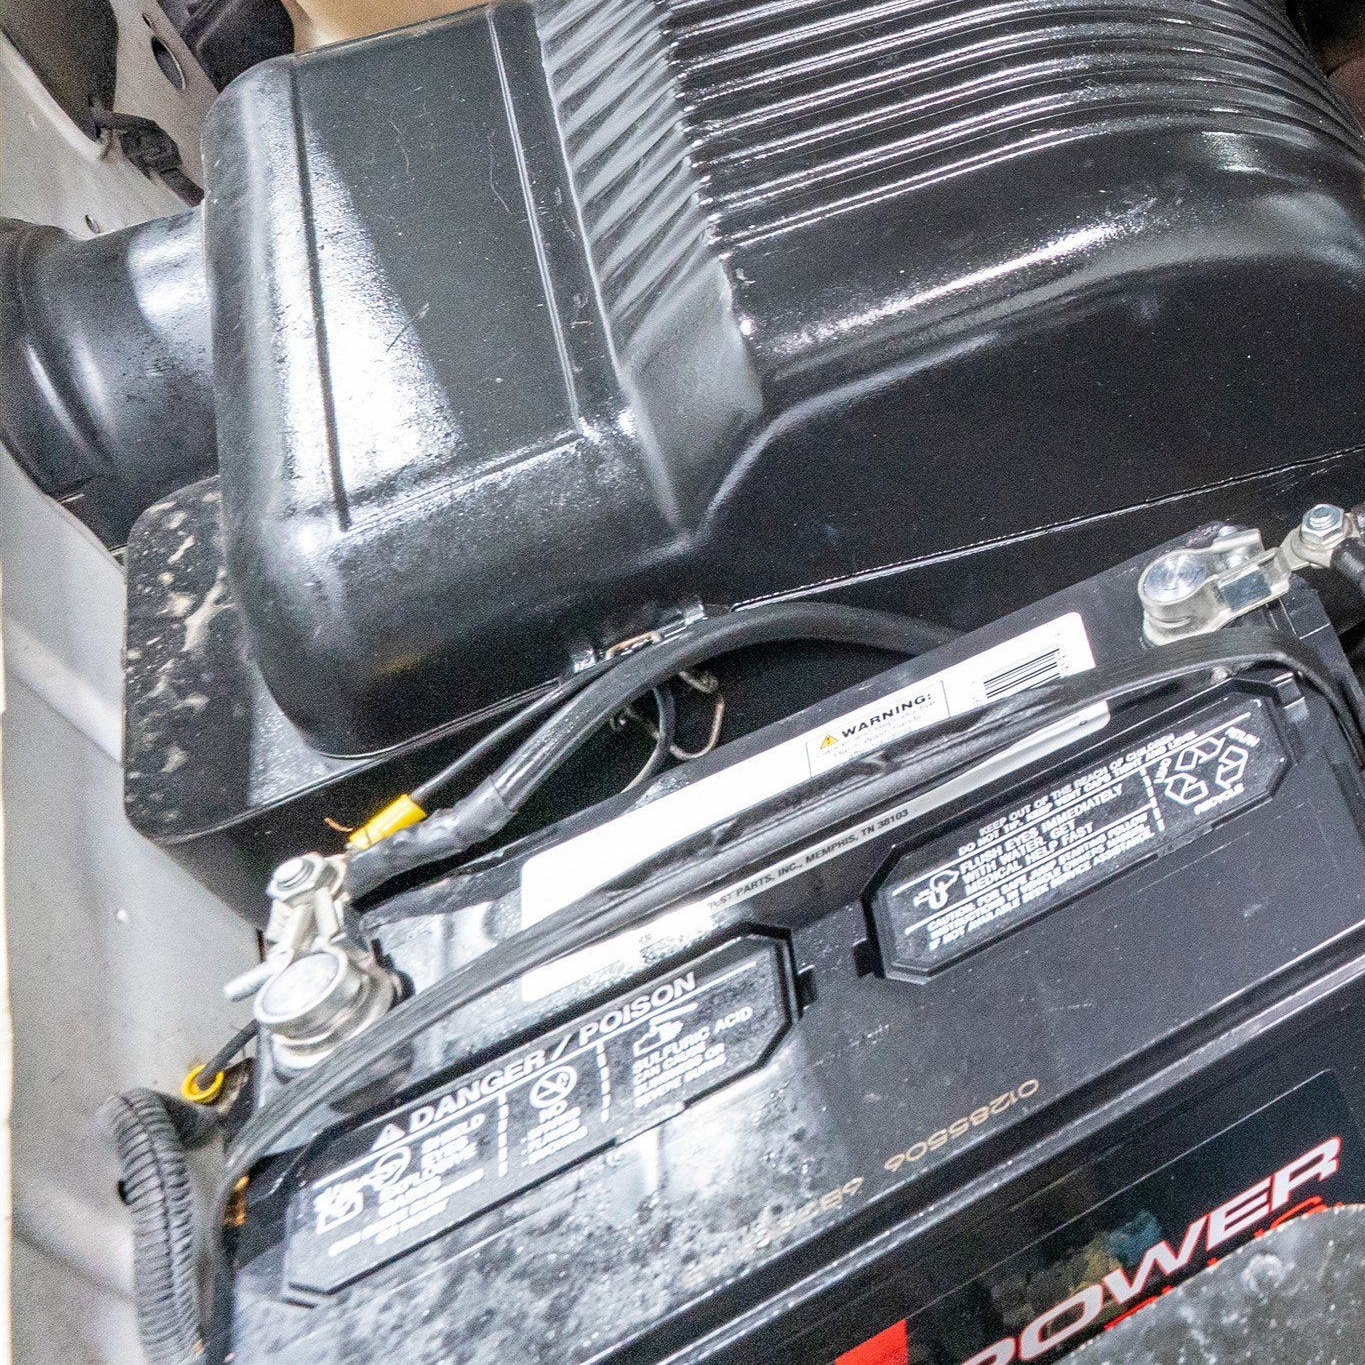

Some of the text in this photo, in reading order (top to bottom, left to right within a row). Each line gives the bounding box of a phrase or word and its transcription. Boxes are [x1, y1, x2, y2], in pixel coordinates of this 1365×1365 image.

[841, 693, 932, 738] WARNING:
[805, 834, 860, 865] MEMPHIS,
[861, 824, 876, 836] TN
[877, 808, 909, 830] 38103
[960, 783, 1123, 875] FLUSH EYES IMMEDIATELY
[962, 860, 997, 884] WITH
[1050, 819, 1076, 839] GET
[964, 822, 1093, 895] MEDICAL HELP FAST
[408, 1051, 547, 1133] DANGER
[578, 970, 698, 1046] POISON
[632, 1006, 753, 1075] SULFURIC ACID
[884, 1078, 1040, 1173] 01285506
